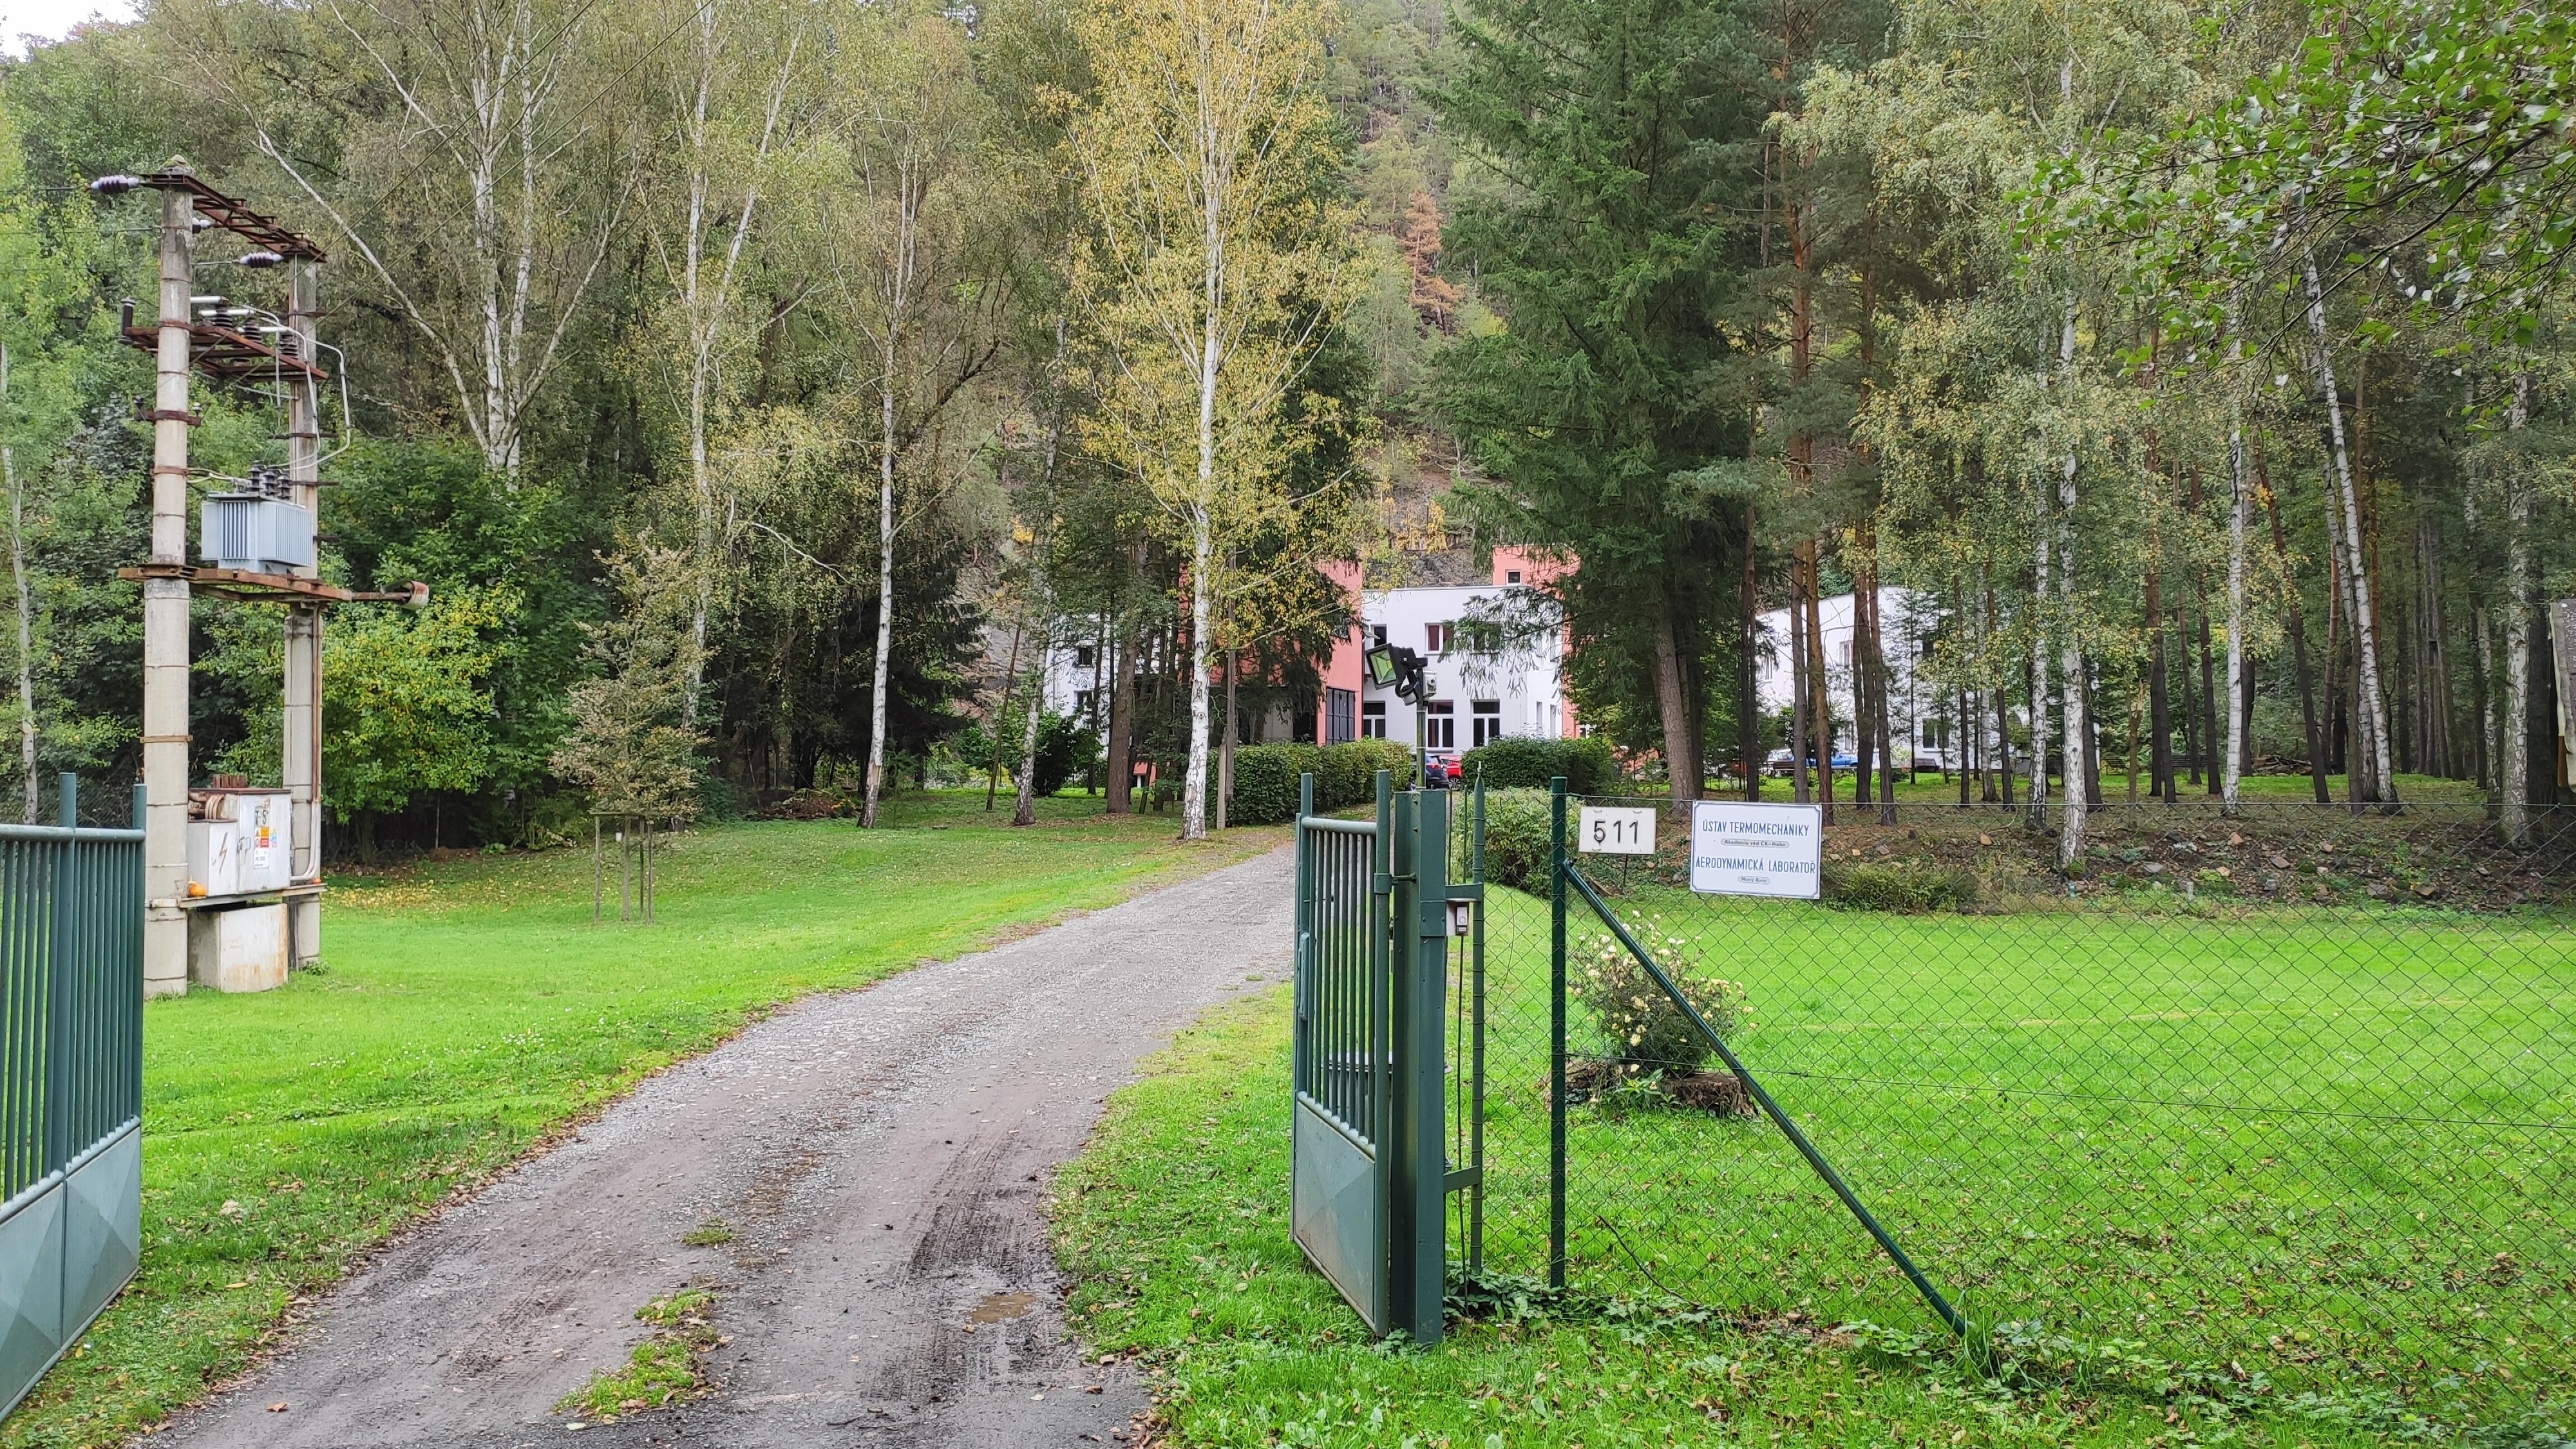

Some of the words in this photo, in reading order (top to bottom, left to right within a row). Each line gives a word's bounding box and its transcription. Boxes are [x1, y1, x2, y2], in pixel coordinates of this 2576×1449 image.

[1593, 819, 1638, 844] 511
[1702, 819, 1727, 831] ÚSTAV
[1730, 820, 1810, 837] TERMOMECHANIKY
[1696, 857, 1765, 871] AERODYNAMICKÁ
[1769, 860, 1816, 874] LABORATOŘ
